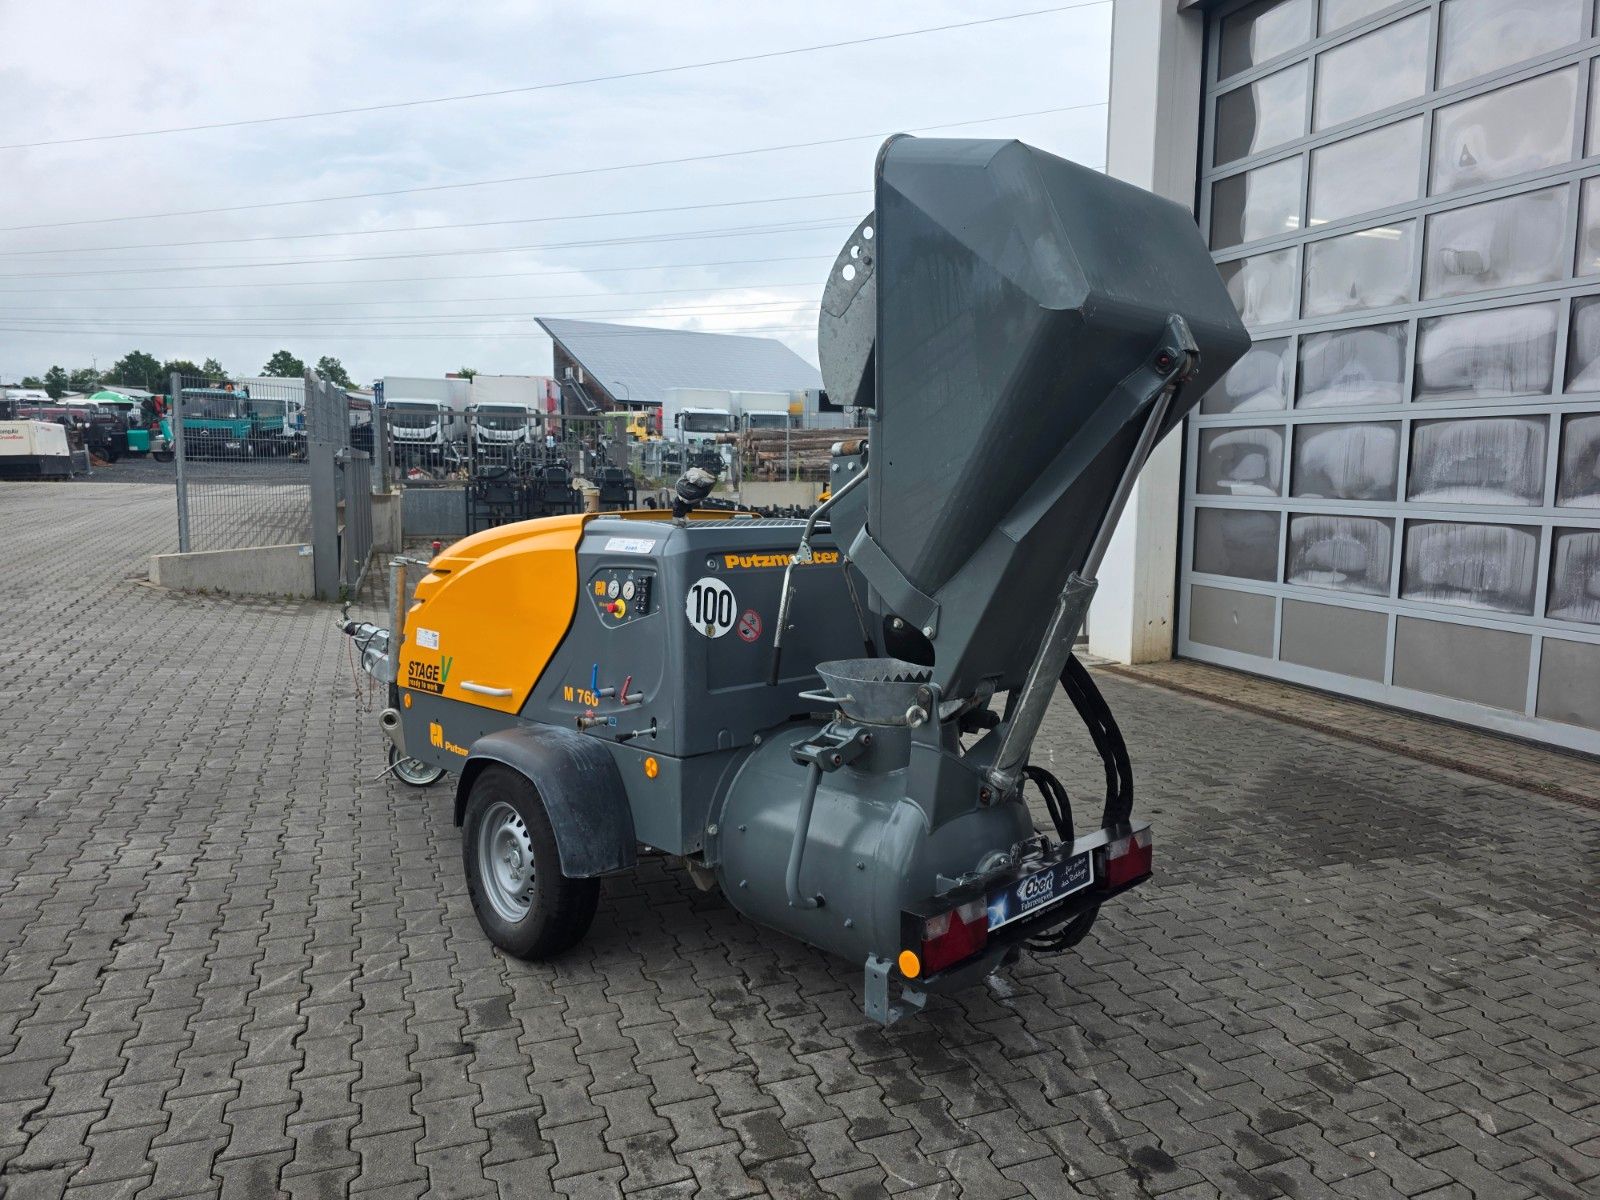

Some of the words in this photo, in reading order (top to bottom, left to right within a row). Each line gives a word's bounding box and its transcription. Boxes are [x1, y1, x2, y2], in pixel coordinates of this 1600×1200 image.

[724, 551, 839, 569] Putzmter
[692, 585, 733, 628] 100
[408, 661, 440, 681] STAGE
[441, 655, 453, 683] V
[564, 686, 574, 702] M
[577, 688, 599, 707] 760
[445, 741, 470, 757] Putzm
[1024, 872, 1054, 898] Ebert
